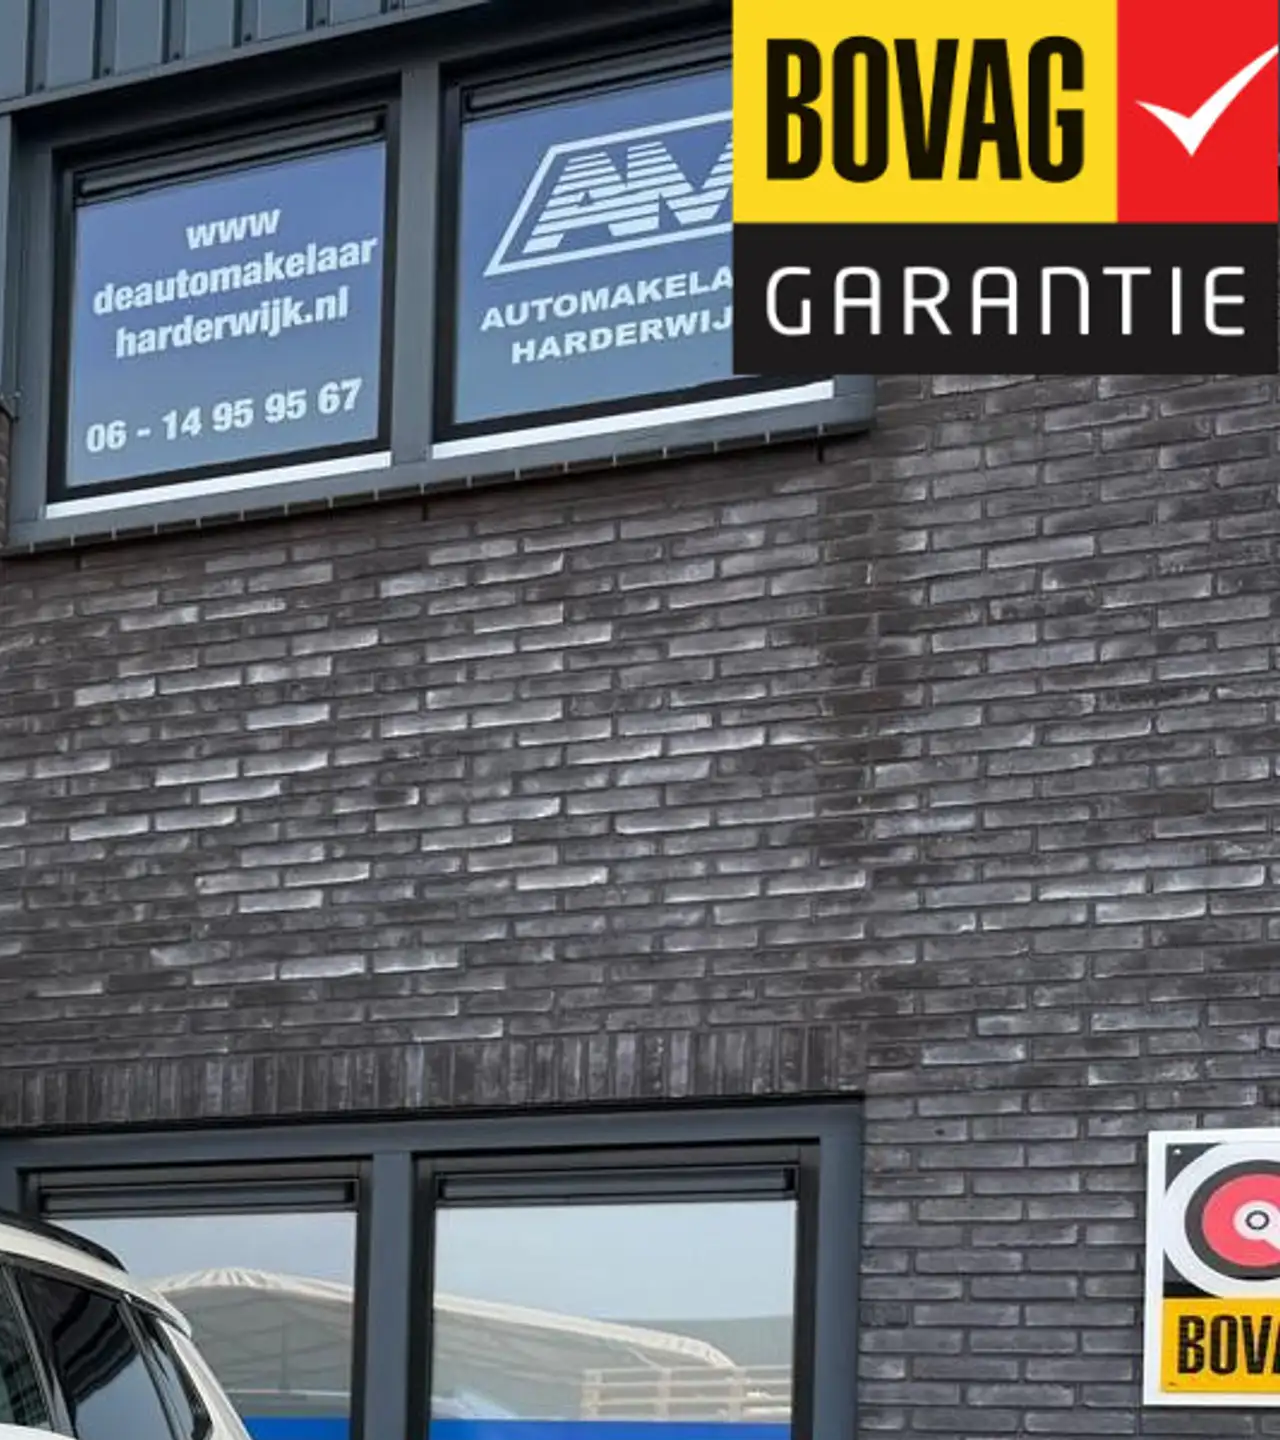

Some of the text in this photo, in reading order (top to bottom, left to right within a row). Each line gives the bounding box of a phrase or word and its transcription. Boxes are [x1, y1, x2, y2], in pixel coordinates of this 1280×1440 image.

[186, 208, 282, 250] www
[92, 237, 378, 316] deautomakelaar
[480, 265, 733, 331] AUTOMAKELA
[116, 285, 349, 359] harderwijk.nl
[511, 305, 732, 364] HARDERWIJ
[86, 419, 127, 452] 06
[162, 406, 202, 440] 14
[212, 398, 254, 432] 95
[265, 389, 307, 424] 95
[318, 377, 362, 415] 67
